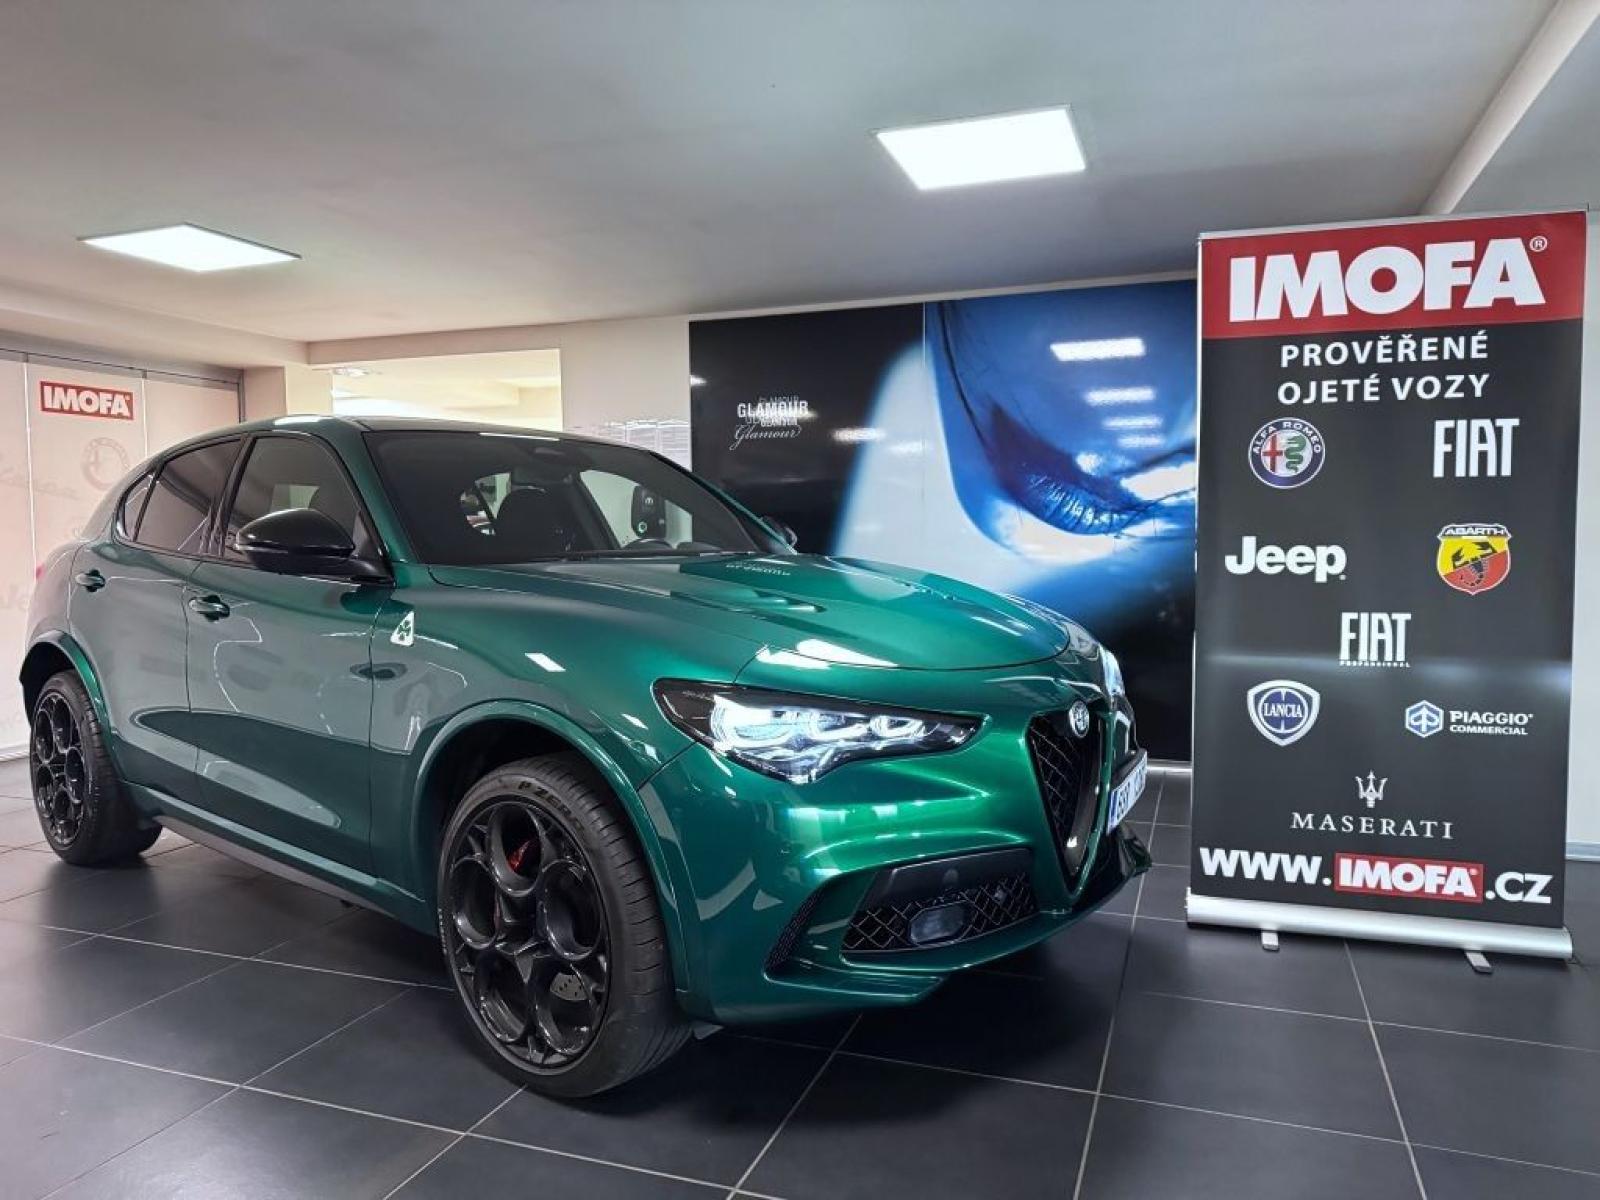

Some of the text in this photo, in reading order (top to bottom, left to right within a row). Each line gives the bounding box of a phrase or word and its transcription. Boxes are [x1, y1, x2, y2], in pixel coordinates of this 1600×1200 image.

[1229, 237, 1545, 322] IMOFA
[1280, 330, 1489, 368] PROVĚŘENÉ
[43, 385, 129, 417] IMOFA
[1277, 374, 1490, 405] OJETÉ VOZY
[1253, 421, 1322, 454] ALFA ROMEO
[1432, 418, 1520, 478] FIAT
[1445, 527, 1504, 535] ABARTH
[1224, 535, 1347, 583] Jeep
[1339, 612, 1411, 661] FIAT
[1263, 702, 1304, 719] LANCIA
[1449, 710, 1529, 726] PIAGGIO
[1449, 725, 1528, 736] COMMERCIAL
[1290, 811, 1454, 839] MASERATI
